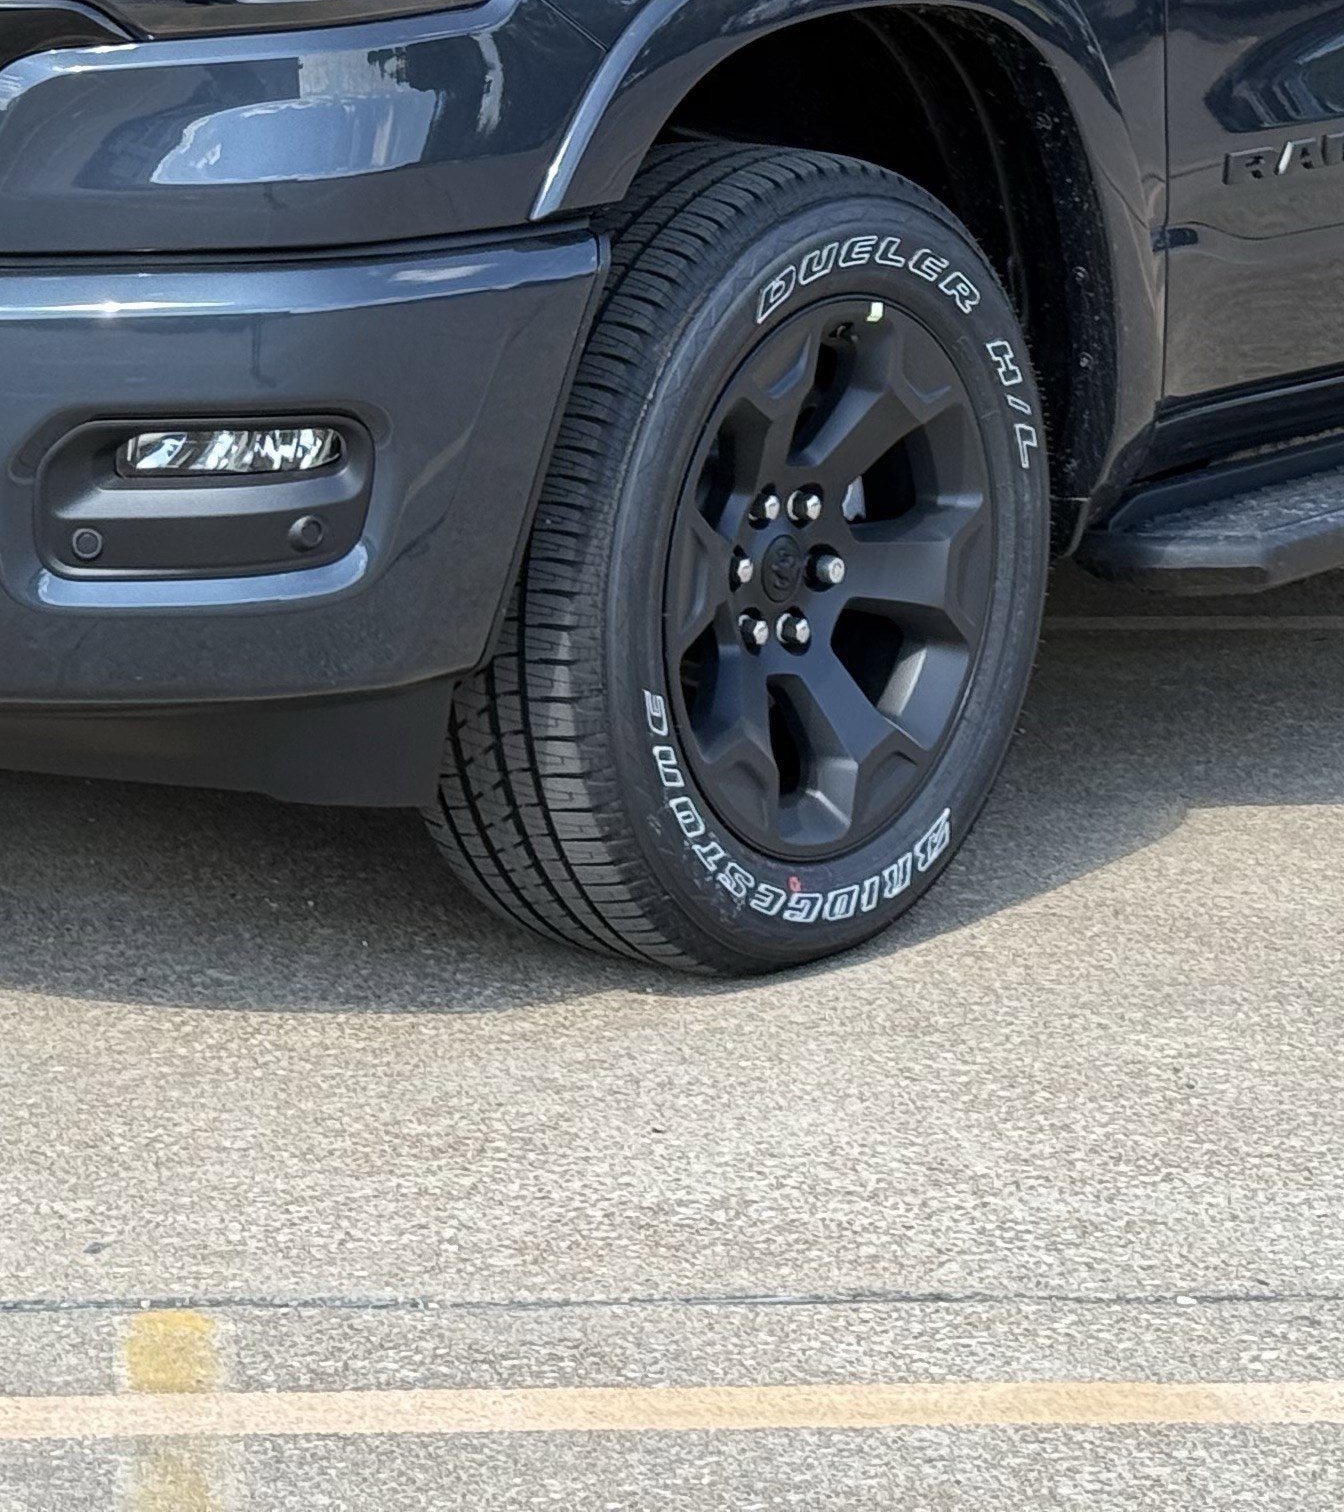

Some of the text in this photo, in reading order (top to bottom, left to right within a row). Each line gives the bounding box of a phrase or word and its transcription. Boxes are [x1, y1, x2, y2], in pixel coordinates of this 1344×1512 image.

[757, 234, 1039, 469] DUELER H/L
[643, 688, 953, 925] BRIDGESTONE
